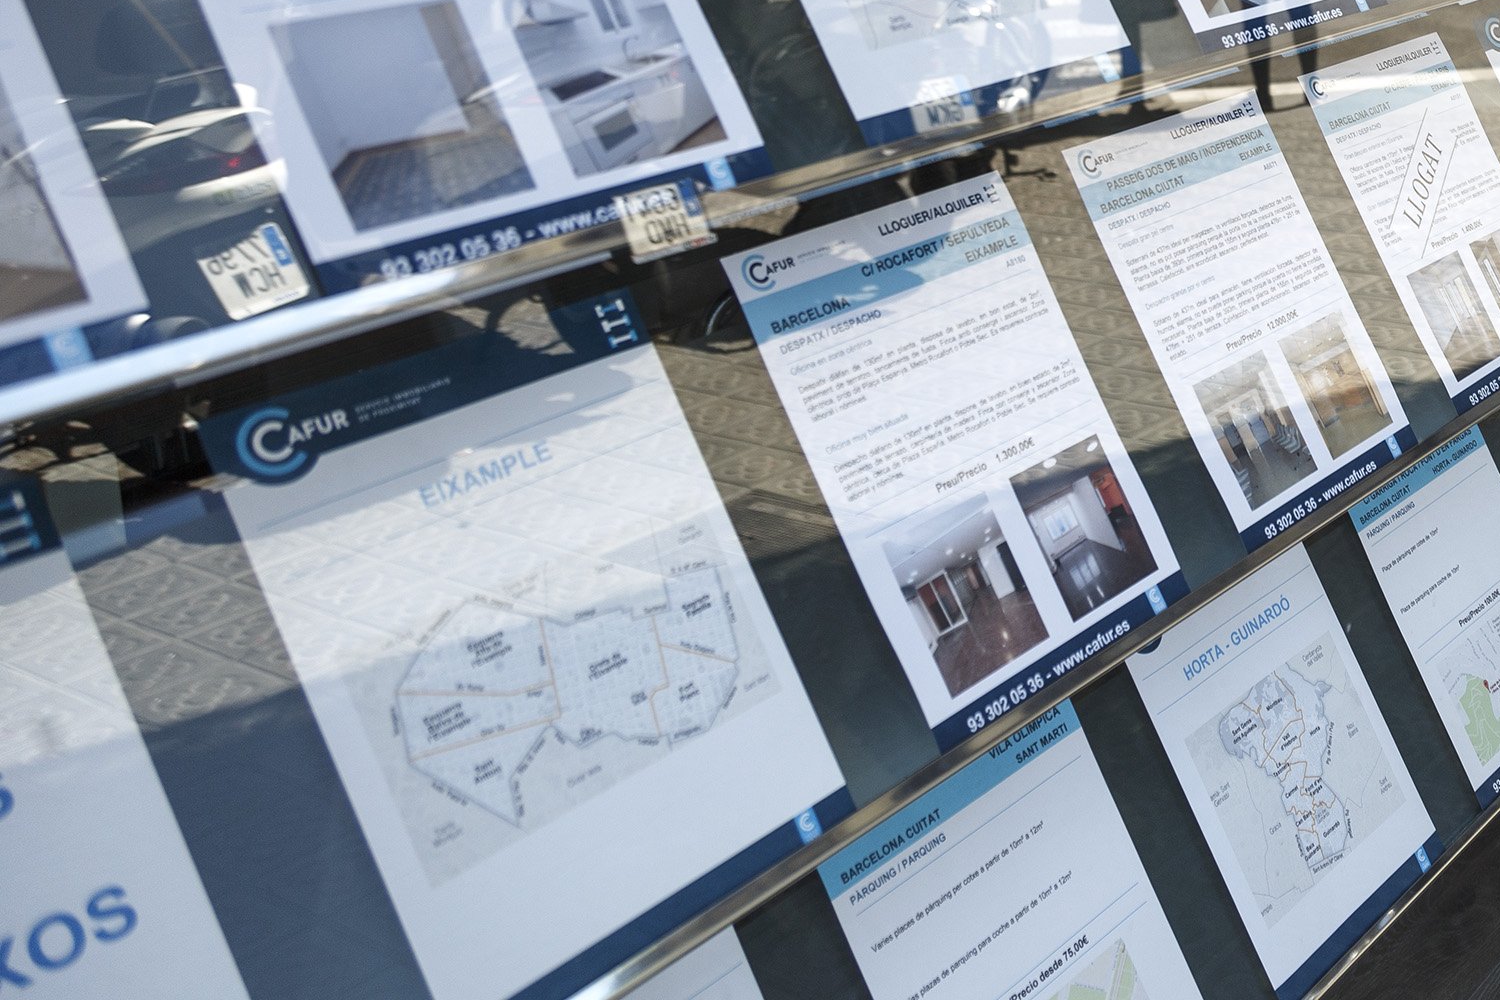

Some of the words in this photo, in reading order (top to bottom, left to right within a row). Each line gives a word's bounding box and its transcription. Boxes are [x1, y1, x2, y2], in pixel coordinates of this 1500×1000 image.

[1220, 33, 1237, 49] 93
[1233, 28, 1254, 45] 302
[1250, 25, 1267, 40] 05
[1263, 21, 1279, 37] 36
[1282, 4, 1344, 32] www.cafur.es
[1375, 46, 1433, 72] LLOGUER/ALQUILER
[1169, 107, 1245, 140] LLOGUER/ALQUILER
[1328, 108, 1369, 130] BARCELONA
[1368, 101, 1392, 116] CIUTAT
[1099, 185, 1156, 214] BARCELONA
[1154, 174, 1186, 194] CIUTAT
[1238, 142, 1273, 162] EIXAMPLE
[1105, 170, 1147, 193] PASSEIG
[1144, 162, 1165, 178] DOS
[1163, 158, 1178, 171] DE
[1176, 151, 1199, 166] MAIG
[1201, 128, 1264, 158] INDEPENDENCIA
[1403, 133, 1444, 229] LLOGAT
[877, 191, 985, 238] LLOGUER/ALQUILER
[1107, 213, 1137, 230] DESPATX
[1138, 200, 1171, 219] DESPACHO
[745, 250, 798, 286] CAFUR
[859, 262, 877, 278] C/
[874, 240, 941, 274] ROCAFORT
[943, 213, 1010, 248] SEPÚLVEDA
[770, 295, 851, 335] BARCELONA
[963, 234, 1019, 264] EIXAMPLE
[778, 330, 826, 356] DESPATX
[829, 308, 883, 336] DESPACHO
[1225, 327, 1263, 352] Preu/Precio
[1266, 308, 1299, 331] 12.000,00€
[252, 409, 349, 463] CAFUR
[419, 440, 553, 508] EIXAMPLE
[934, 459, 988, 494] Preu/Precio
[994, 435, 1036, 465] 1.300,00€
[1359, 497, 1392, 525] BARCELONA
[1390, 483, 1411, 503] CUITAT
[1431, 457, 1450, 475] HORTA
[1451, 438, 1478, 462] GUINARDO
[1263, 522, 1279, 540] 93
[1275, 511, 1295, 532] 302
[1292, 503, 1307, 522] 05
[1303, 496, 1318, 514] 36
[1320, 457, 1377, 503] www.cafur.es
[1365, 517, 1390, 540] PÀRQUING
[1391, 500, 1416, 522] PARQUING
[1182, 644, 1225, 681] HORTA
[1230, 595, 1291, 647] GUINARDÓ
[1458, 600, 1485, 628] Preu/Precio
[965, 710, 987, 735] 93
[983, 694, 1011, 723] 302
[1008, 683, 1028, 707] 05
[1025, 672, 1045, 696] 36
[1051, 617, 1131, 679] www.cafur.es
[987, 736, 1013, 759] VILA
[839, 832, 906, 885] BARCELONA
[904, 808, 942, 840] CUITAT
[1014, 740, 1040, 764] SANT
[1038, 721, 1068, 748] MARTI
[848, 865, 897, 906] PÀRQUING
[900, 832, 947, 870] PARQUING
[870, 932, 894, 954] Varies
[892, 916, 916, 939] places
[923, 888, 953, 917] pàrquing
[951, 882, 964, 896] per
[962, 869, 980, 886] cotxe
[983, 852, 1002, 872] partir
[1038, 956, 1063, 983] desde
[1061, 933, 1089, 963] 75,00€
